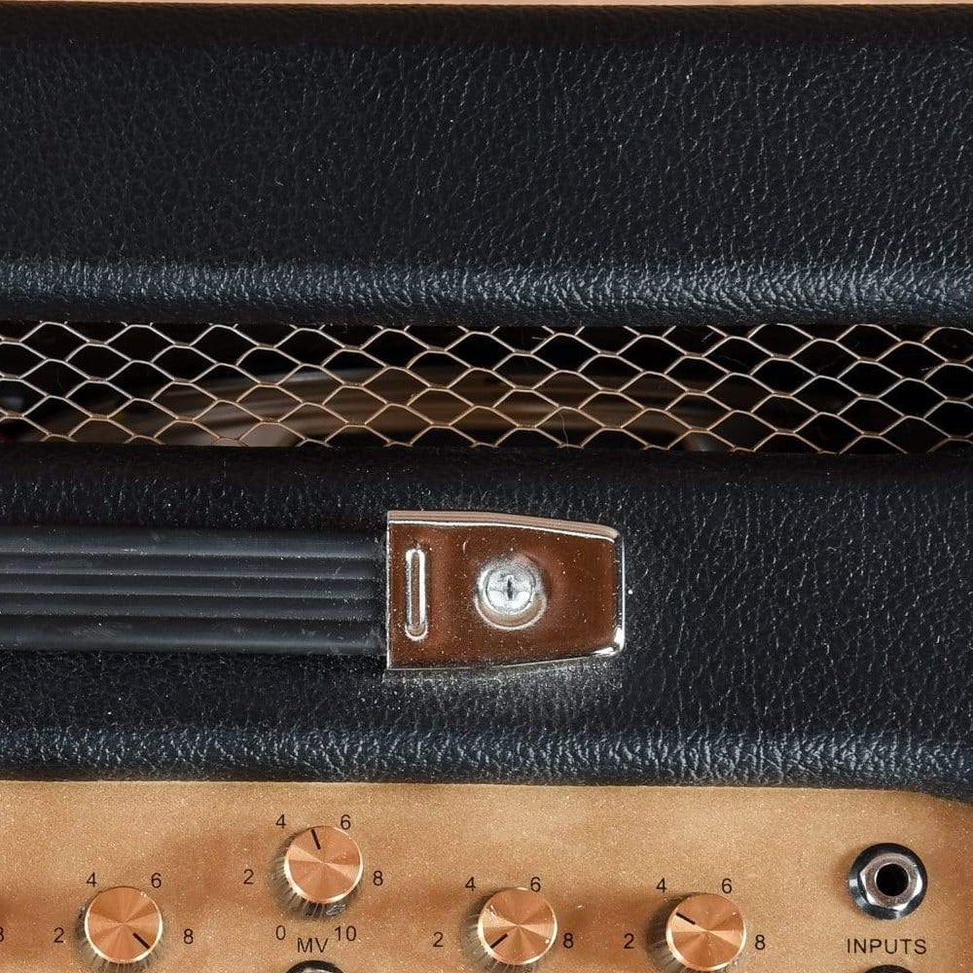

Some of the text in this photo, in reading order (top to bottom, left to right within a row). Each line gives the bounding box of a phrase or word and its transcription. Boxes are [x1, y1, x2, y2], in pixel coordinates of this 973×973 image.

[275, 814, 287, 830] 4
[340, 814, 352, 831] 6
[85, 871, 97, 888] 4
[150, 872, 162, 889] 6
[242, 868, 254, 885] 2
[372, 870, 384, 887] 8
[464, 876, 477, 892] 4
[530, 876, 542, 893] 6
[655, 877, 668, 894] 4
[721, 877, 733, 894] 6
[53, 926, 65, 944] 2
[183, 928, 194, 945] 8
[275, 924, 286, 941] 0
[334, 925, 357, 942] 10
[432, 931, 444, 948] 2
[563, 932, 575, 950] 8
[297, 937, 329, 953] MV
[623, 933, 635, 950] 2
[754, 934, 766, 951] 8
[847, 938, 927, 954] INPUTS
